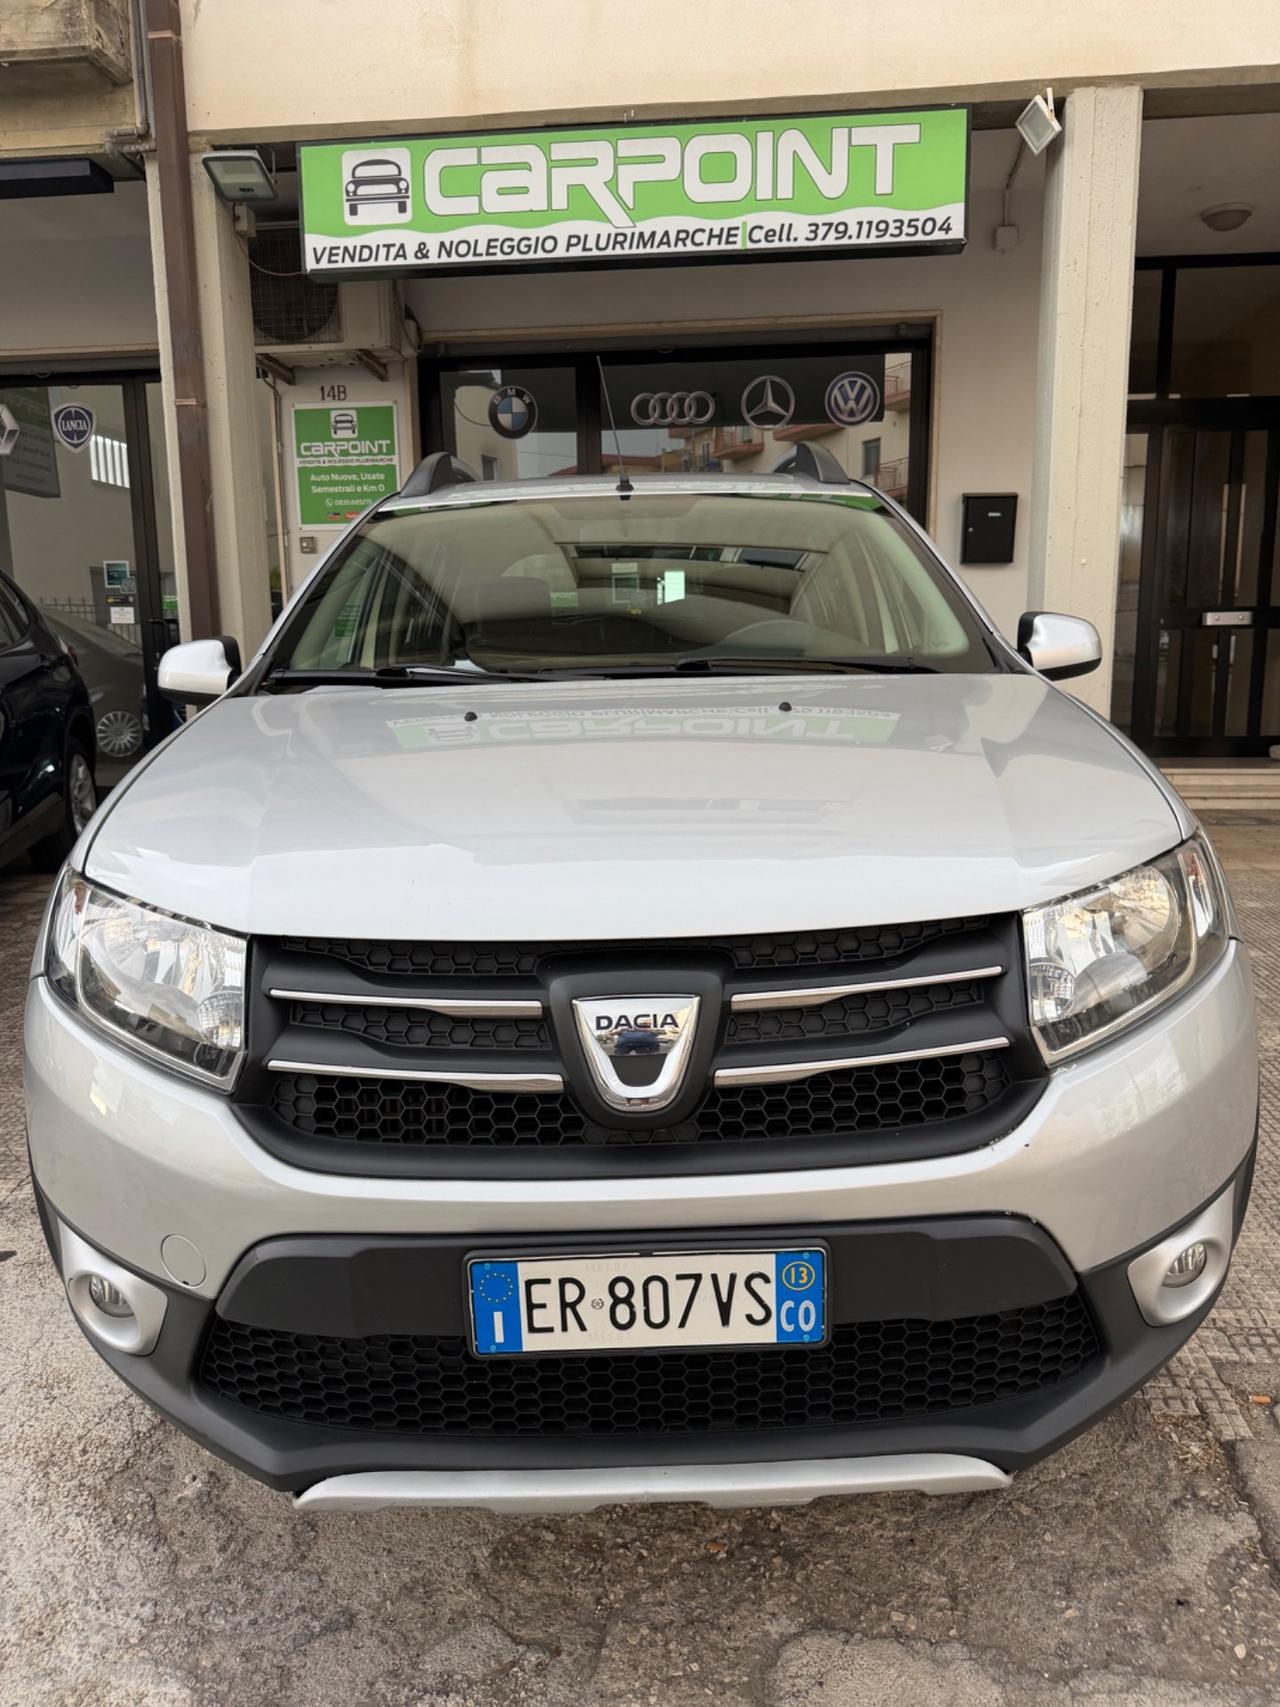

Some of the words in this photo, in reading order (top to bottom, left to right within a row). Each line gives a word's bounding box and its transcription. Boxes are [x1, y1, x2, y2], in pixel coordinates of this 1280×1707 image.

[312, 243, 408, 265] VENDITA
[414, 241, 430, 259] &
[437, 235, 558, 258] NOLEGGIO
[565, 226, 740, 251] PLURIMARCHE
[748, 225, 798, 243] Cell.
[805, 216, 952, 242] 379.1193504
[320, 385, 347, 401] 14B
[61, 419, 88, 431] LANCIA
[310, 473, 330, 481] Auto
[311, 484, 356, 494] Semestrali
[363, 484, 377, 492] Km
[595, 1013, 679, 1030] DACIA
[790, 1263, 808, 1283] 13
[780, 1299, 817, 1332] CO
[493, 1310, 505, 1344] I
